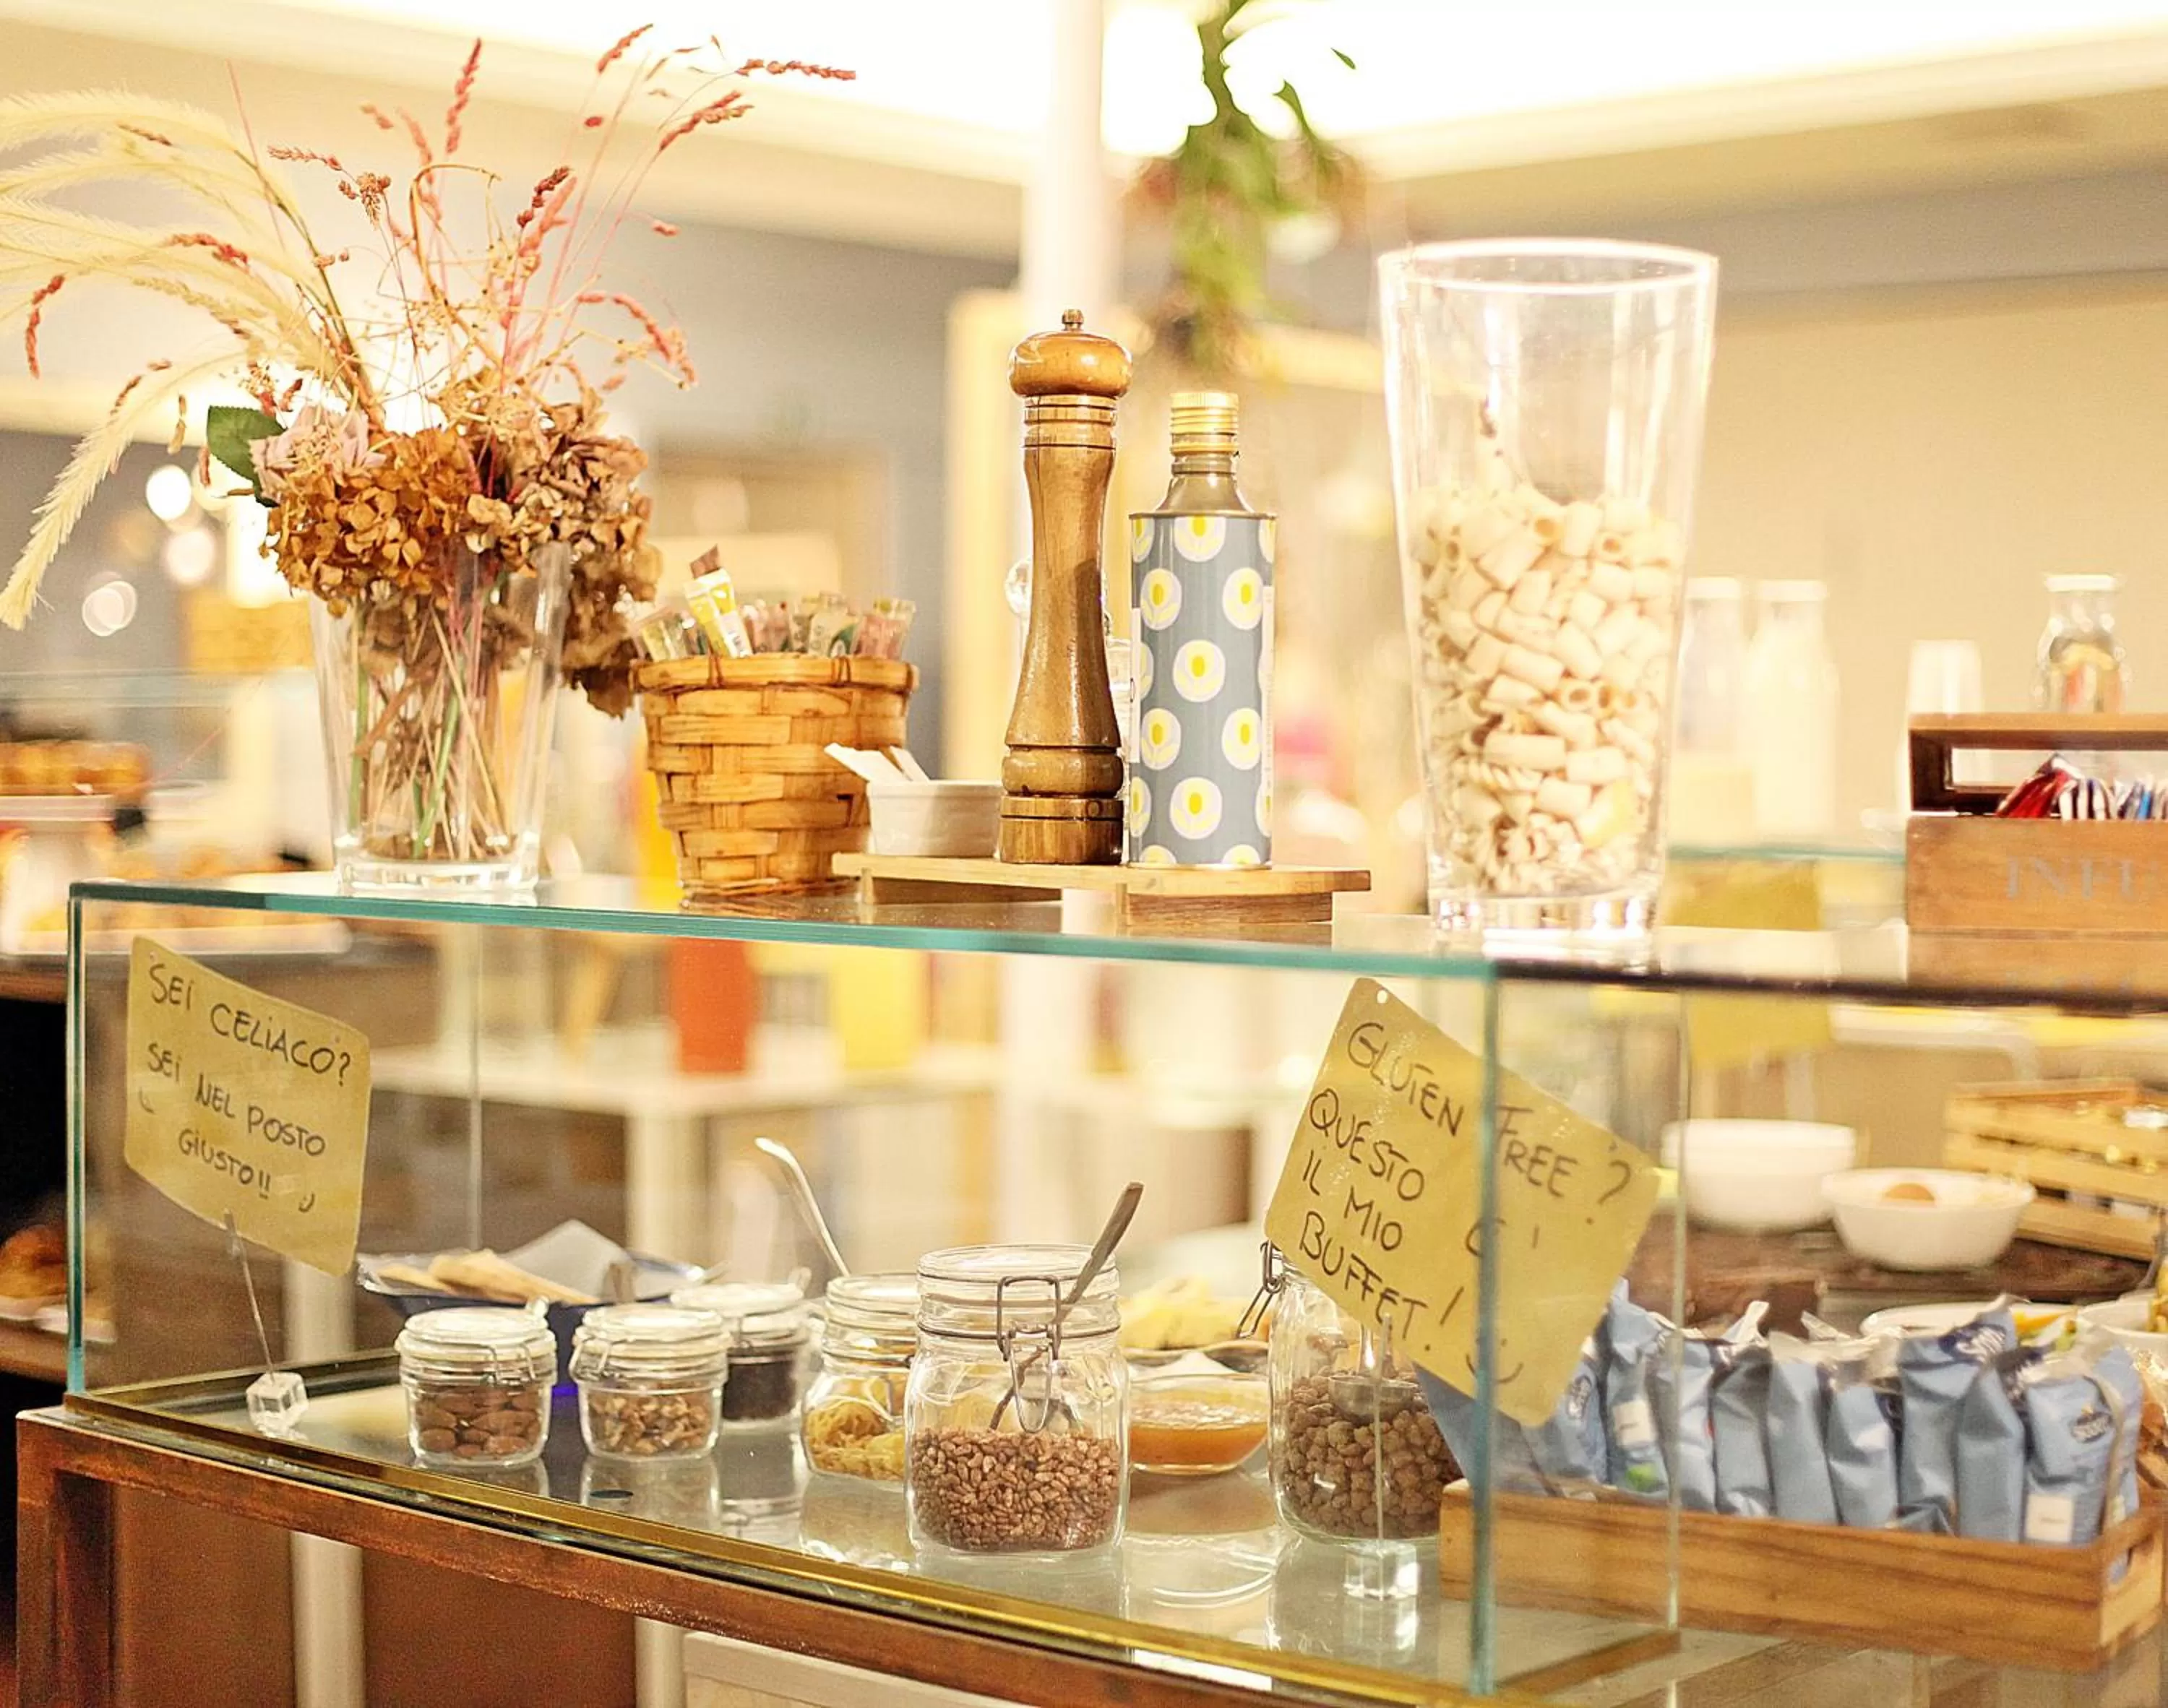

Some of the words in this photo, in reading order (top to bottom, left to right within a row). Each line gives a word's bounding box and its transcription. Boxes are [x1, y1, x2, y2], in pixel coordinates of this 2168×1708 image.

[195, 1073, 236, 1120] NEL
[247, 1105, 327, 1157] POSTO
[1347, 1022, 1466, 1138] GLUTEN
[1308, 1088, 1427, 1202] QUESTO
[1343, 1186, 1404, 1252] MIO
